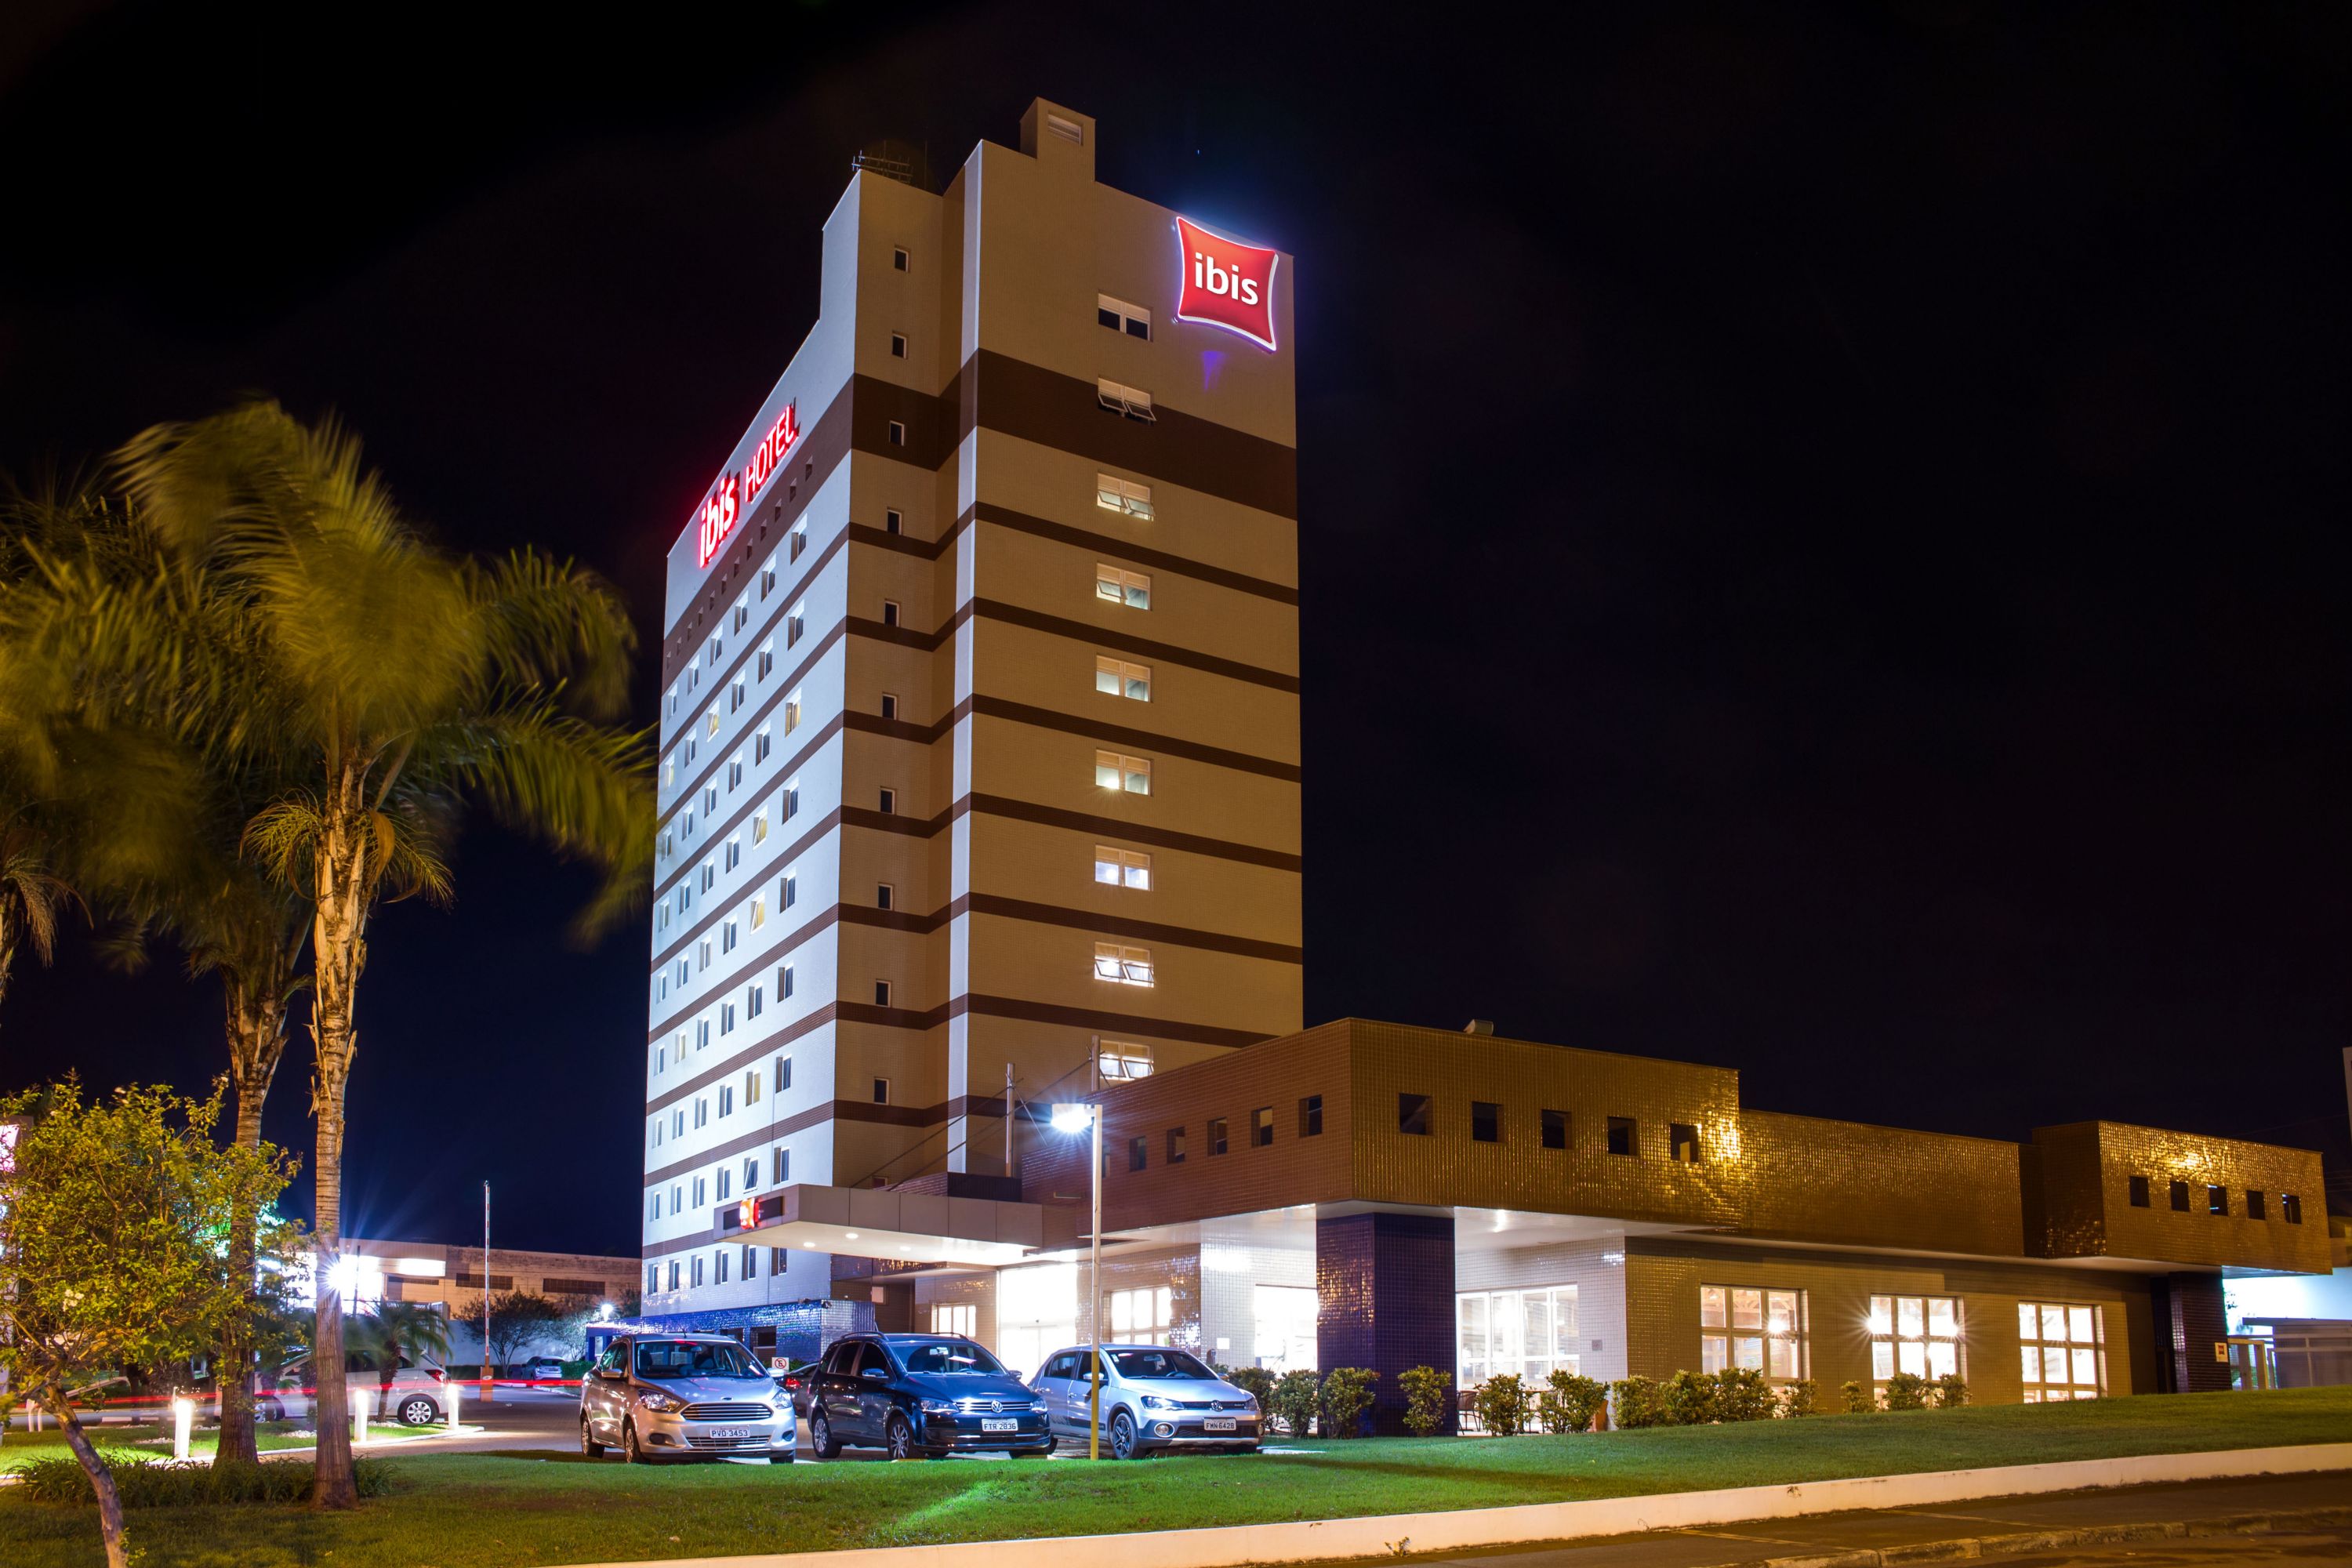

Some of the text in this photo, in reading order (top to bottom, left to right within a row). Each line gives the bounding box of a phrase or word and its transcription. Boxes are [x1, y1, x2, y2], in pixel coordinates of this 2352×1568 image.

[1194, 251, 1259, 306] ibis
[699, 405, 796, 569] ibis HOTEL
